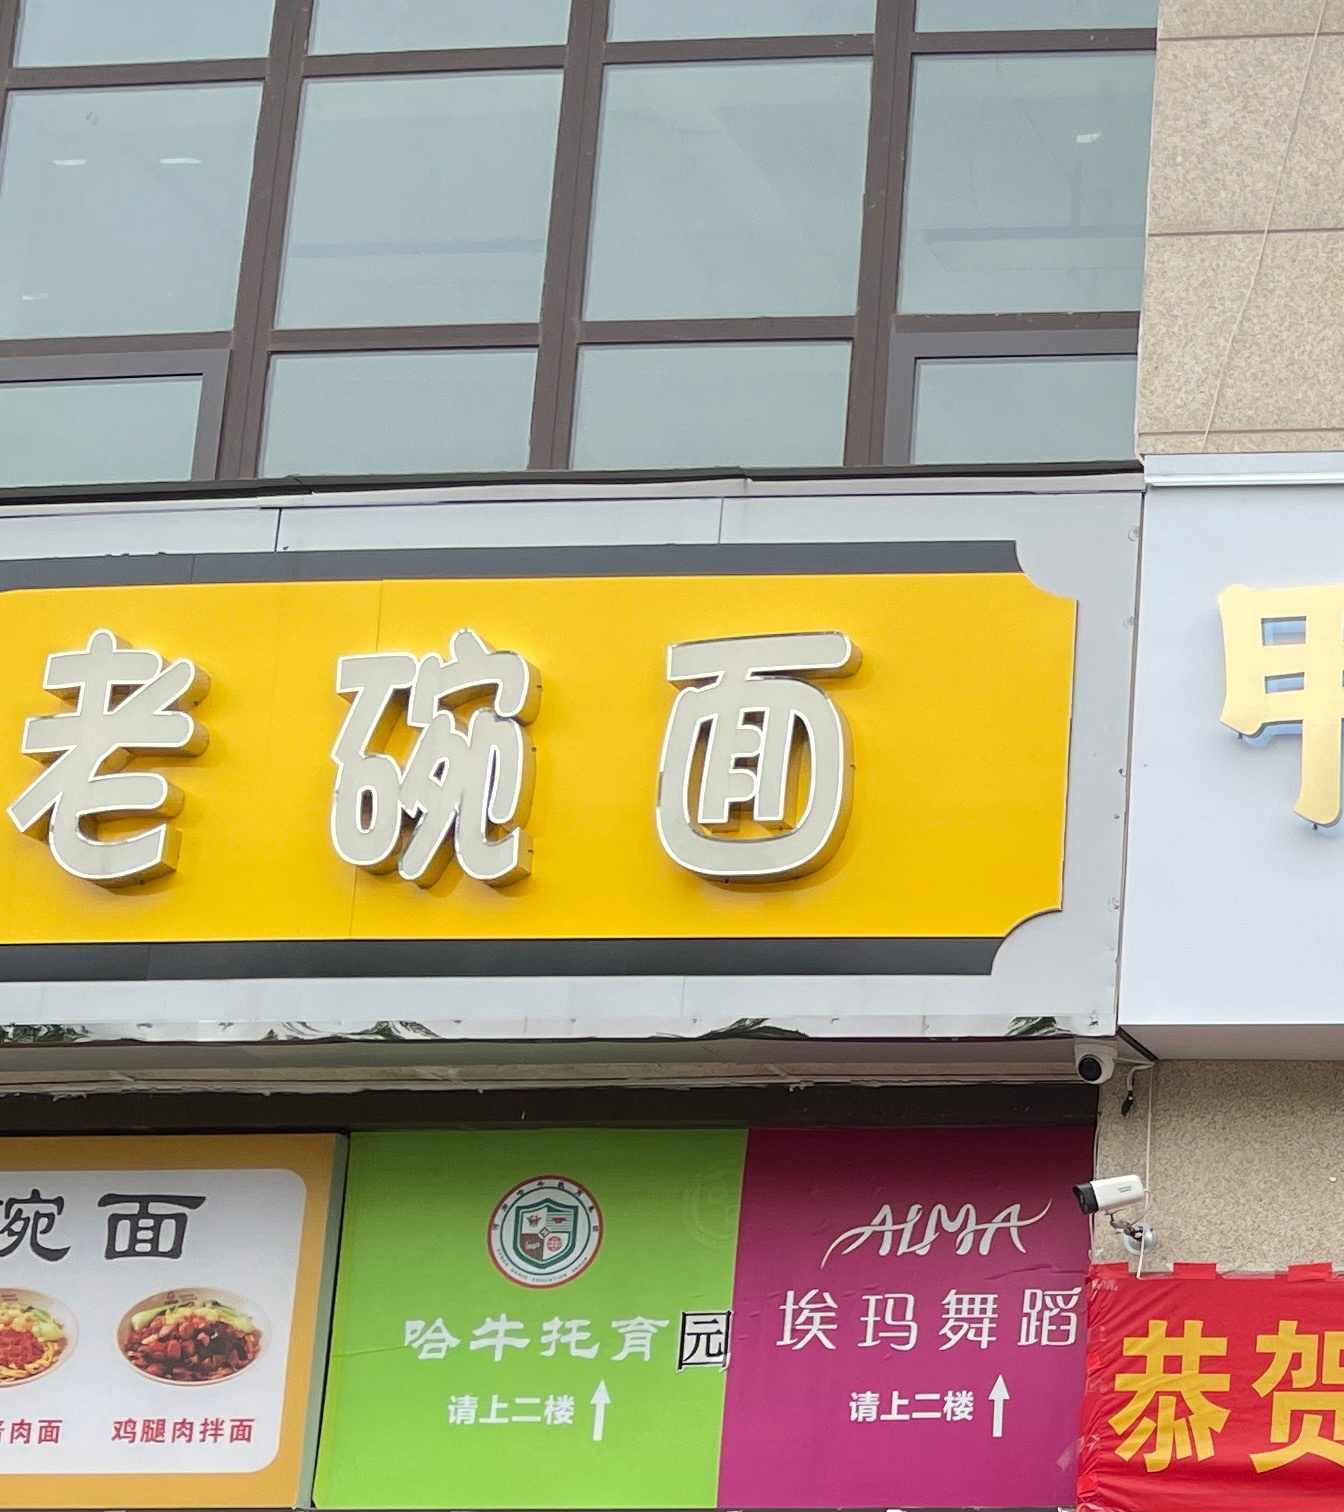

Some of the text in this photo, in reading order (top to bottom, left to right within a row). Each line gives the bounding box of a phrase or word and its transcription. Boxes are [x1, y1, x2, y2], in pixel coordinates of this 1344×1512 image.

[7, 628, 863, 886] 老碗面
[776, 1286, 1084, 1351] 埃玛舞蹈
[447, 1393, 576, 1425] 请上二楼
[848, 1390, 974, 1423] 请上二楼
[111, 1417, 256, 1445] 鸡腿肉拌面
